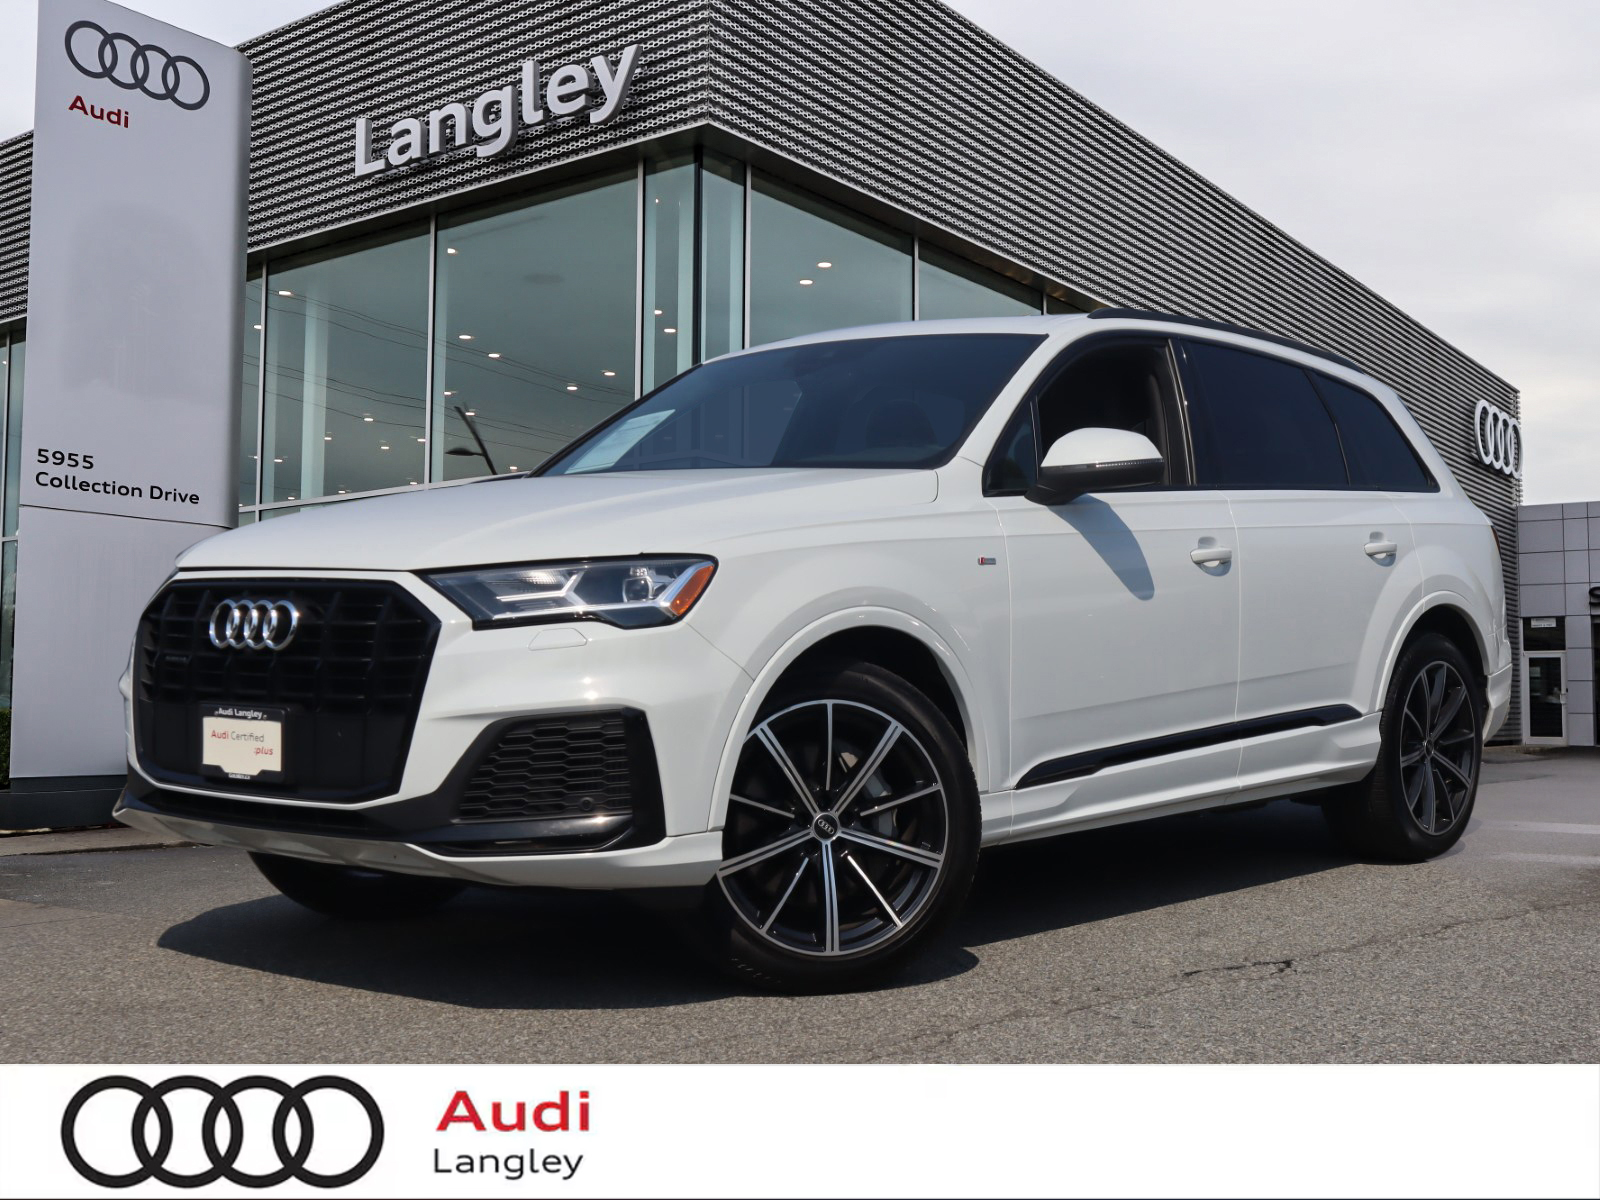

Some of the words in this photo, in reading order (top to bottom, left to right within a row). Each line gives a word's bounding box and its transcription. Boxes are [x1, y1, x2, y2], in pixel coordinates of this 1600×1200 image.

[68, 95, 129, 129] Audi
[354, 43, 643, 177] Langley
[36, 448, 94, 470] 5955
[35, 471, 143, 498] Collection
[149, 485, 200, 505] Drive
[218, 707, 234, 716] Audi
[234, 708, 263, 720] Langley
[210, 730, 230, 740] Audi
[230, 731, 265, 743] Certified
